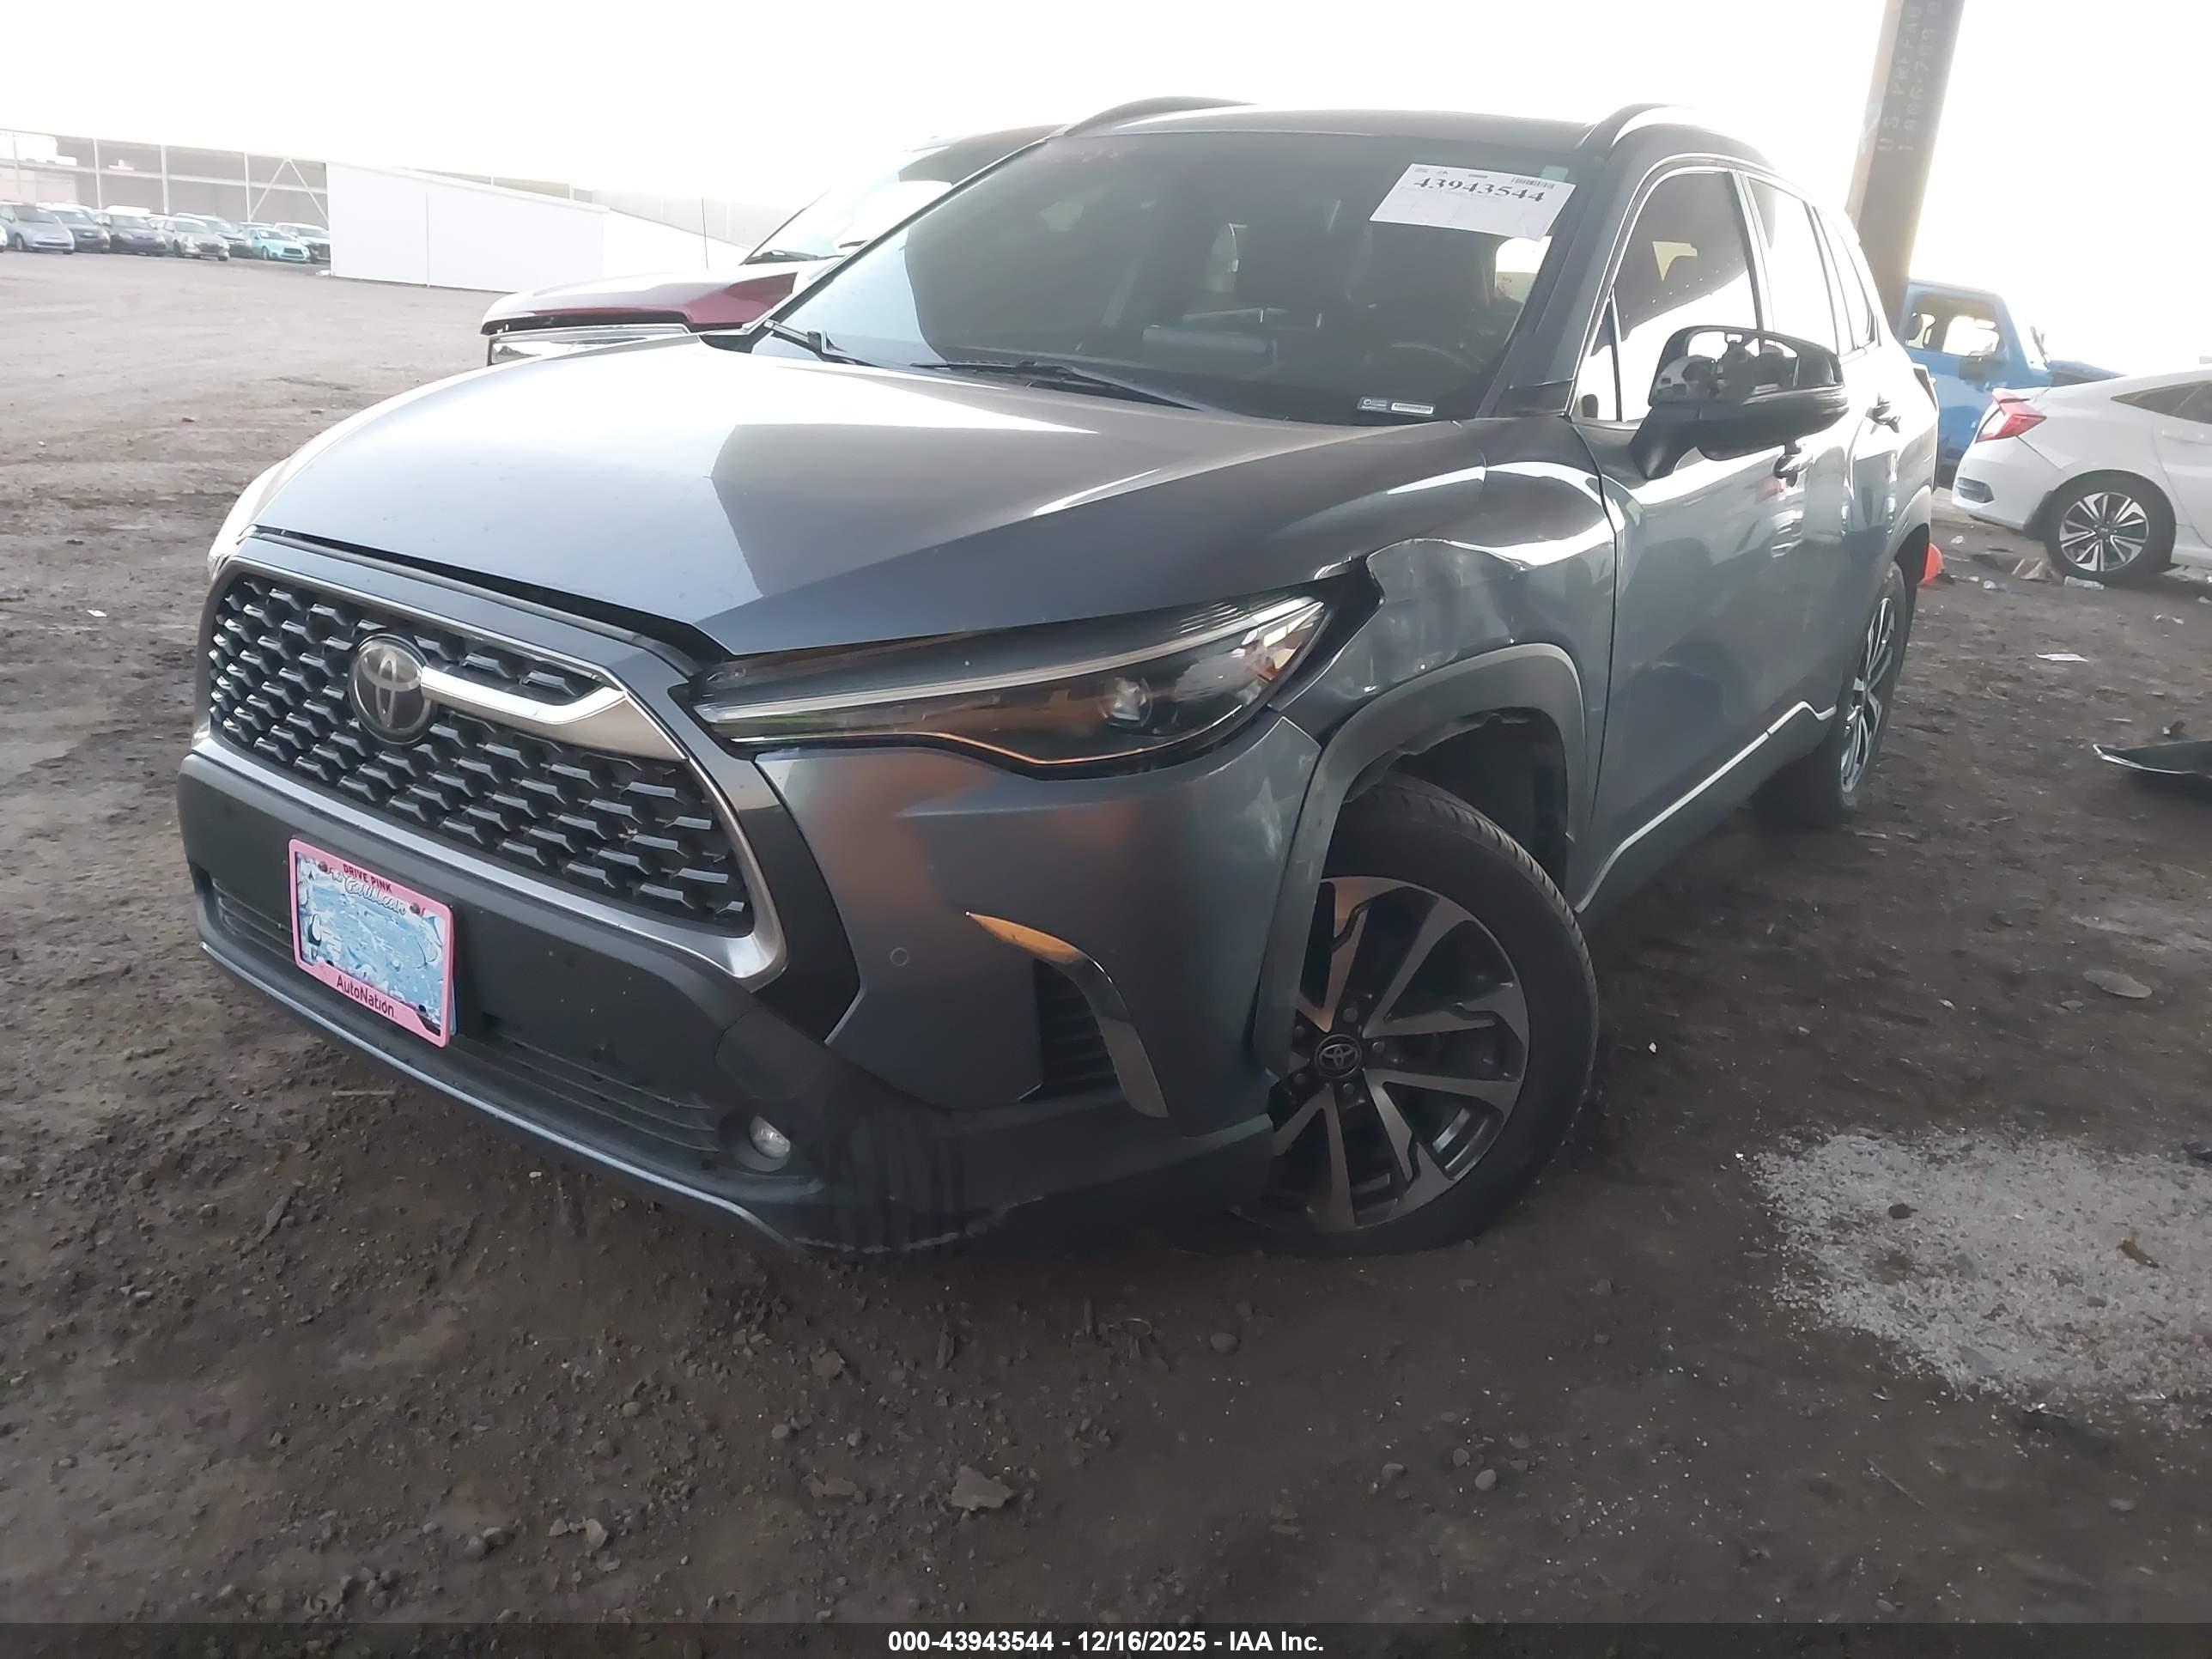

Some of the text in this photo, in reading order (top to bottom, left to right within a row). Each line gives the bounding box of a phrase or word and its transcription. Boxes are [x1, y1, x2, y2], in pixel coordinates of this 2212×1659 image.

[1414, 178, 1546, 203] 43943544
[343, 864, 392, 893] DRIVE PINK
[337, 975, 394, 1018] AutoNation
